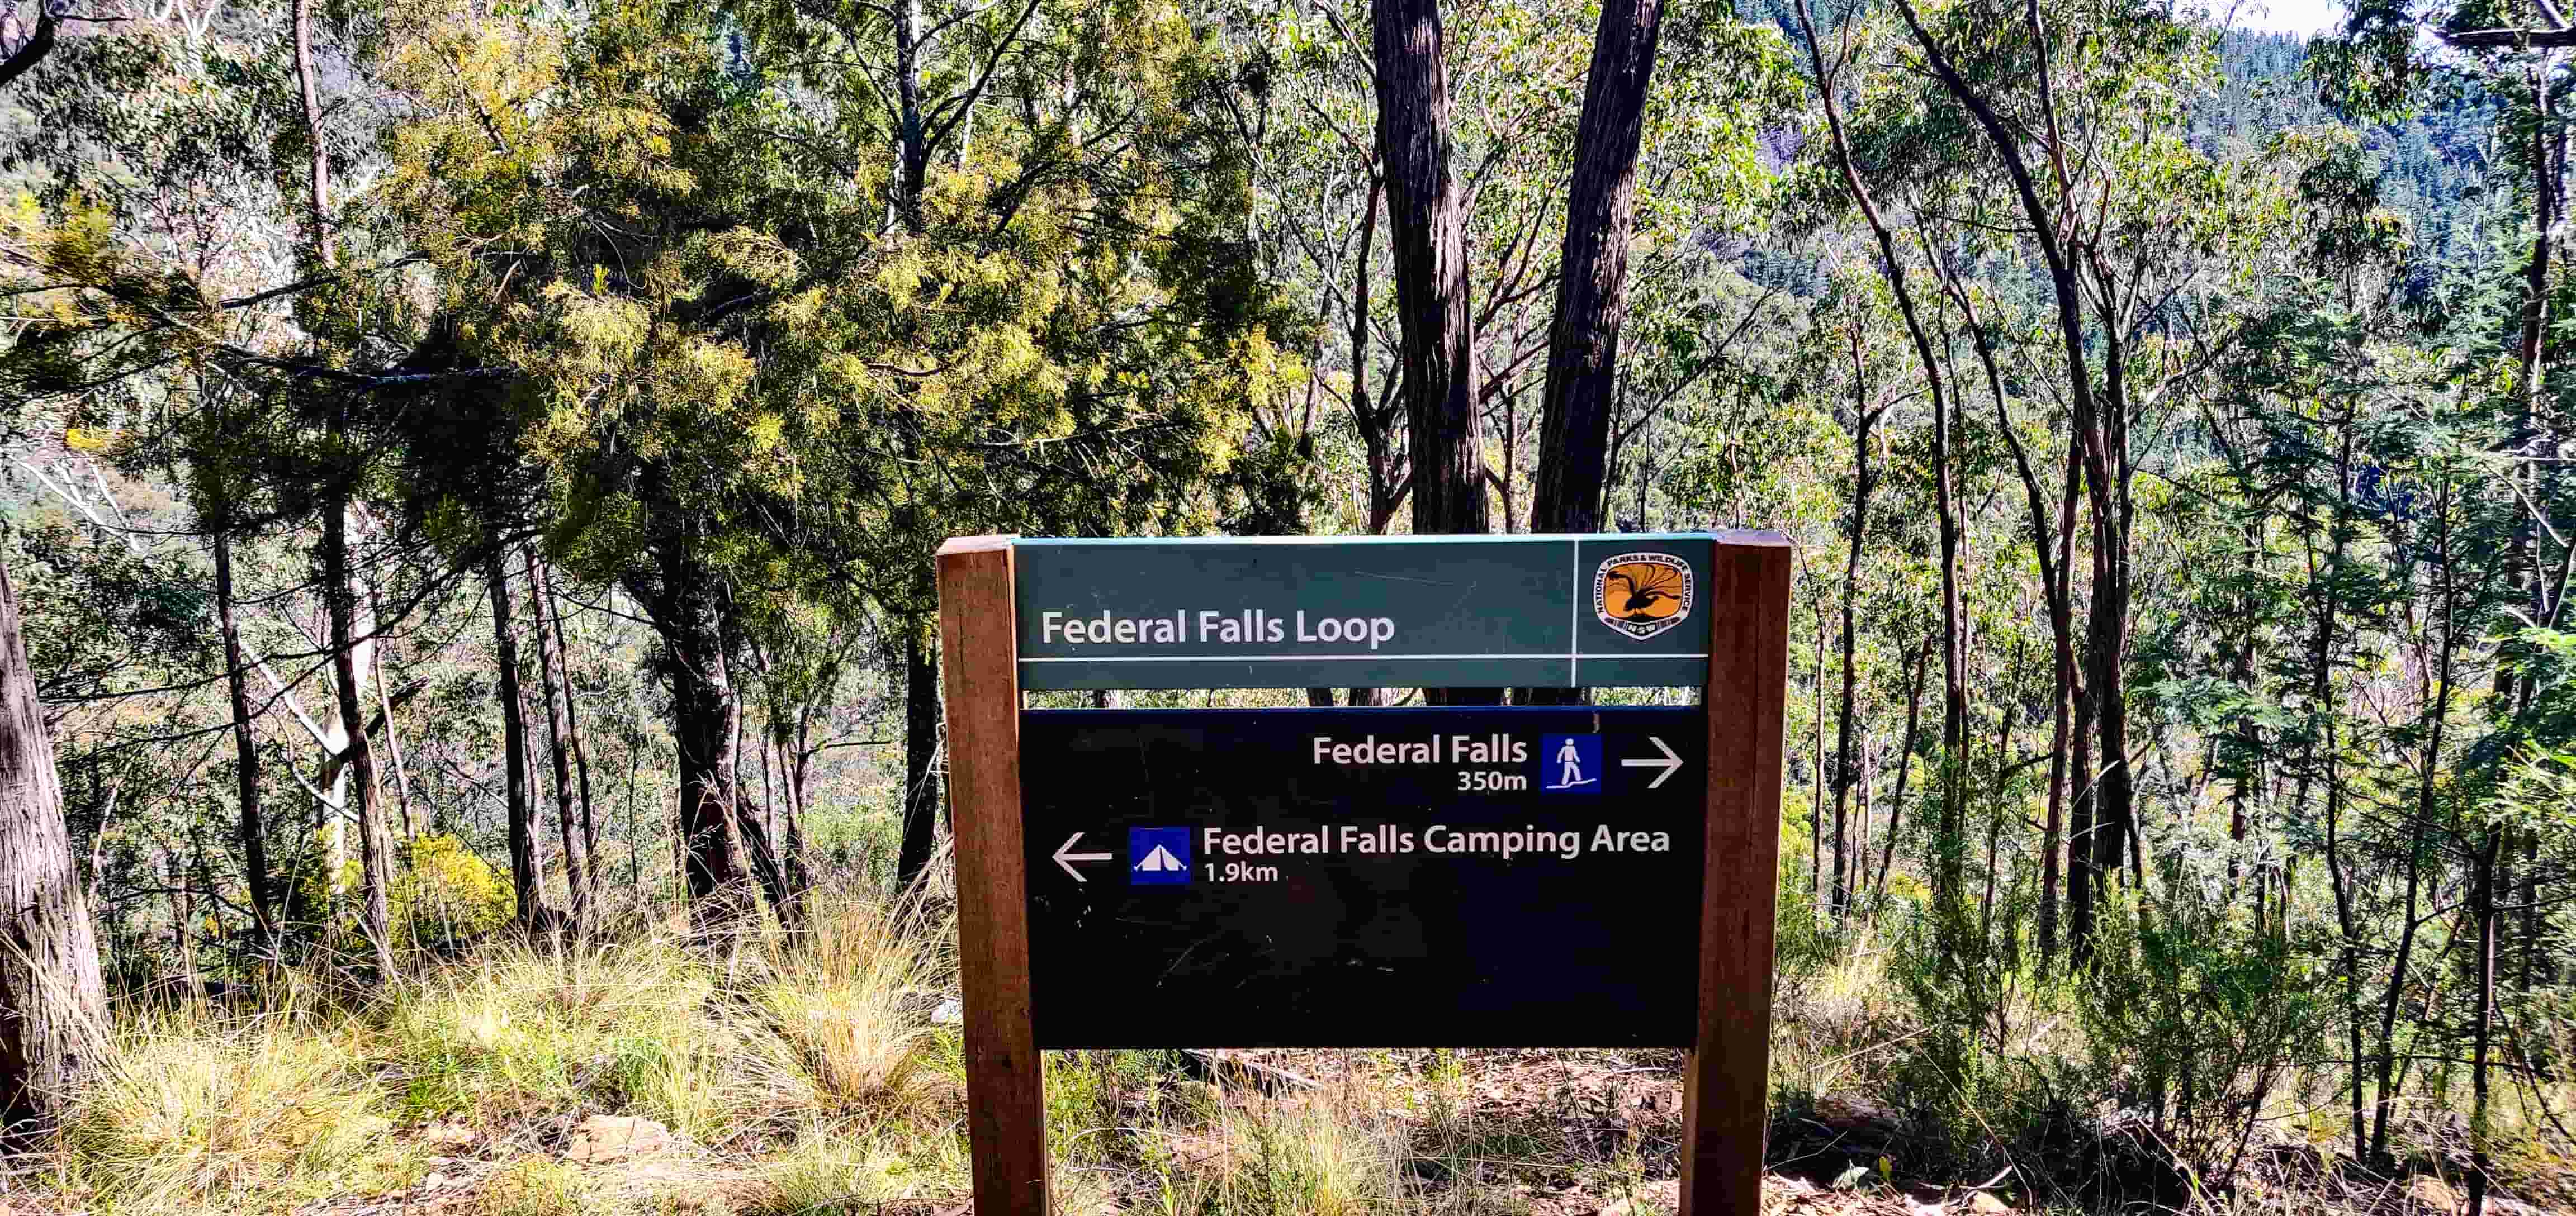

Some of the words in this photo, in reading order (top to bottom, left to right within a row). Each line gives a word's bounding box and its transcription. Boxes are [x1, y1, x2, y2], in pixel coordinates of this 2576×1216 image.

[1042, 610, 1186, 643] Federal
[1199, 609, 1284, 642] Falls
[1296, 610, 1395, 649] Loop
[1627, 624, 1656, 634] NSW
[1314, 734, 1440, 763] Federal
[1452, 733, 1527, 762] Falls
[1457, 771, 1527, 791] 350m
[1204, 825, 1329, 854] Federal
[1341, 824, 1414, 853] Falls
[1424, 825, 1580, 859] Camping
[1591, 824, 1670, 852] Area
[1205, 861, 1278, 882] 1.9km
